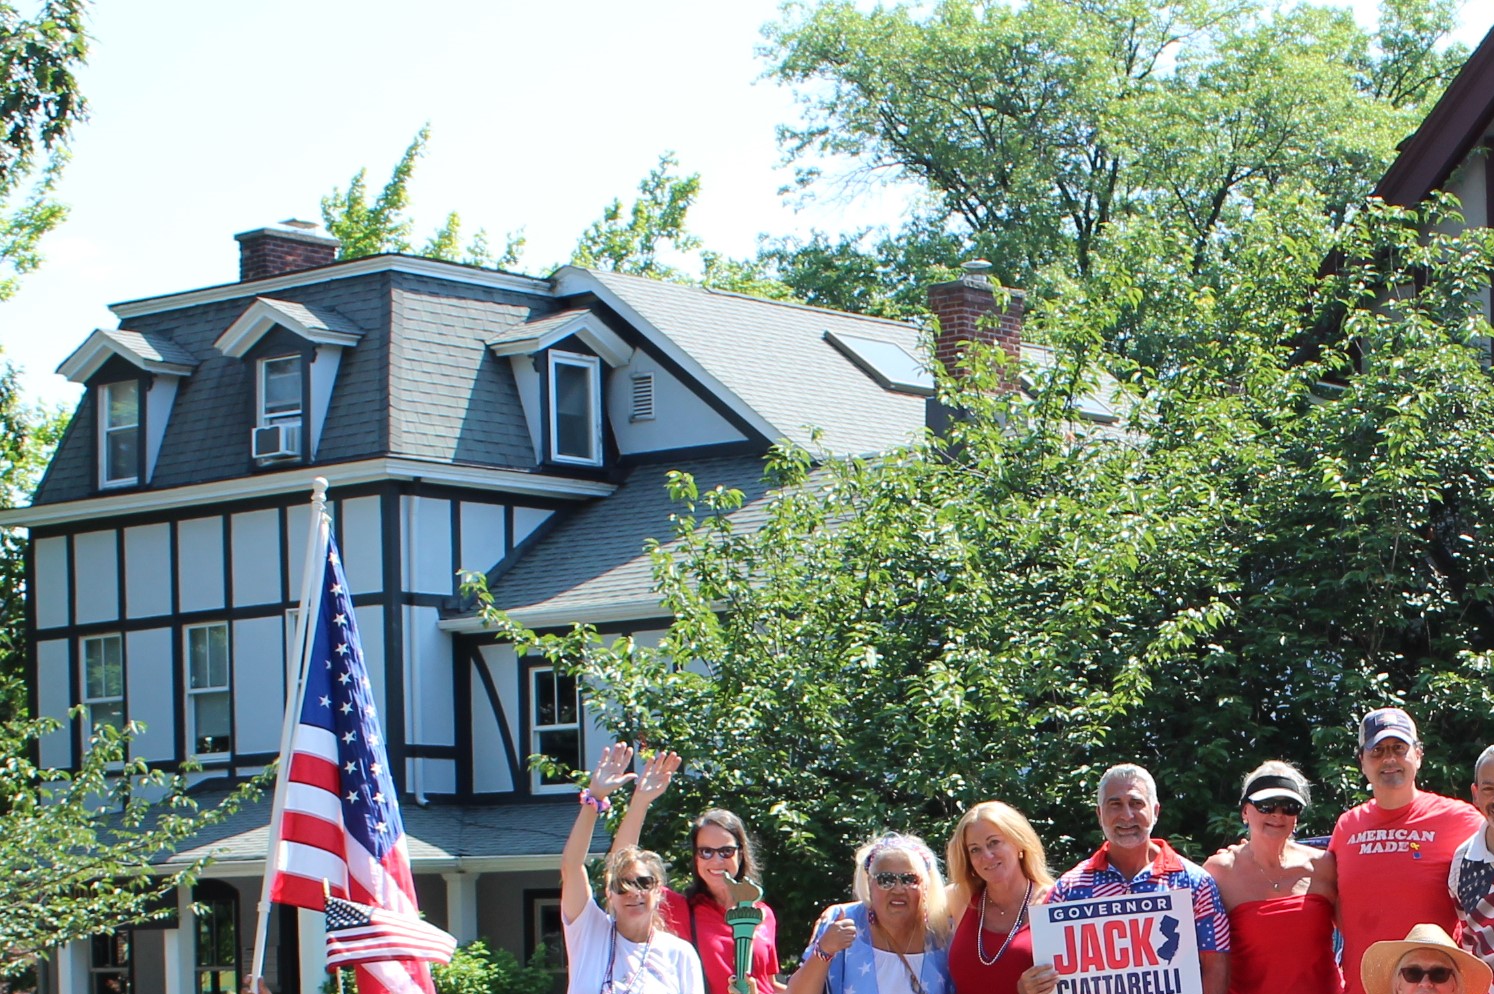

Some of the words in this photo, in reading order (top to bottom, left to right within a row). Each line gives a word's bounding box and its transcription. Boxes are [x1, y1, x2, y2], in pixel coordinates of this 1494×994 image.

[1347, 829, 1436, 845] AMERICAN
[1359, 841, 1410, 855] MADE
[1054, 898, 1168, 921] GOVERNOR
[1054, 917, 1159, 976] JACK
